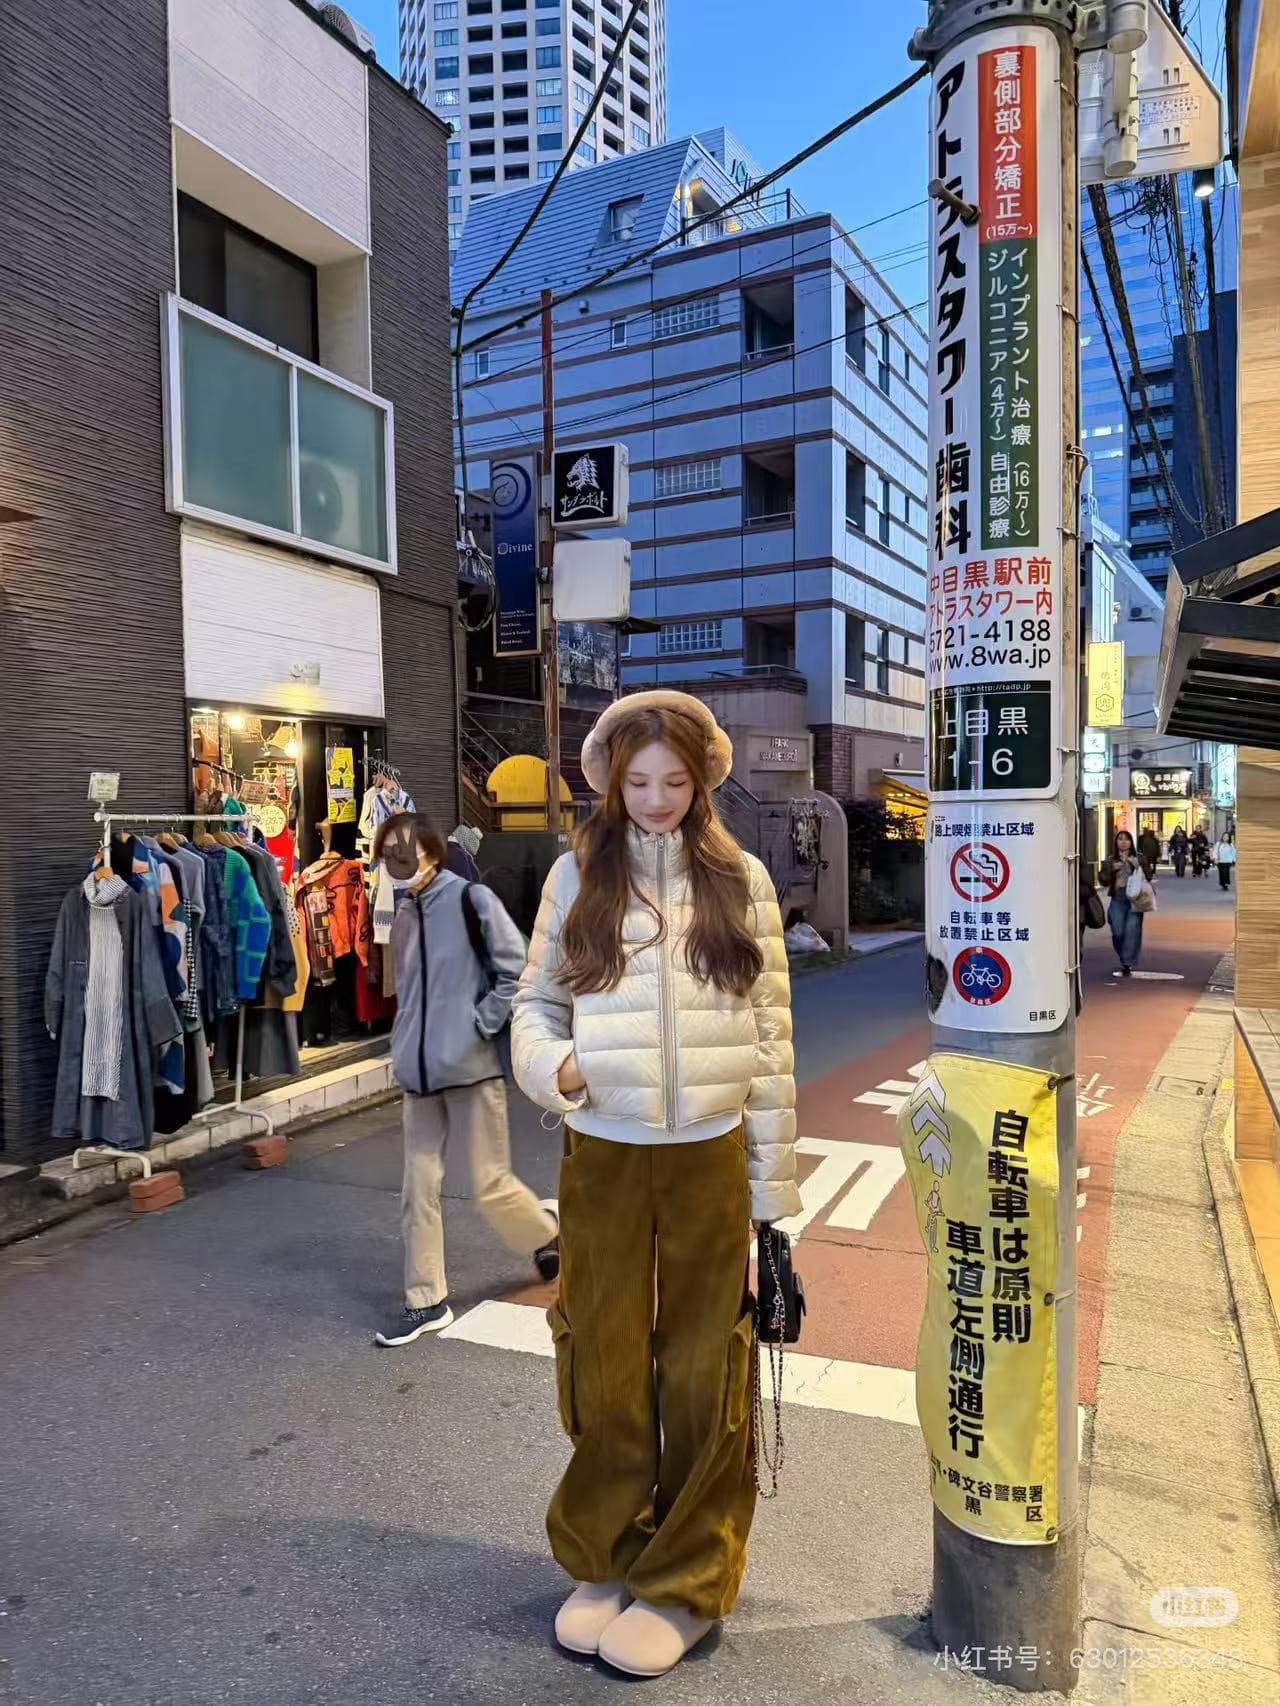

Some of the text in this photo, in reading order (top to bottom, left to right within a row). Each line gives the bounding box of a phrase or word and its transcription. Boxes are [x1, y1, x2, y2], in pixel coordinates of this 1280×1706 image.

[993, 51, 1022, 220] 裏側部分矯正
[497, 542, 533, 555] Divine
[930, 556, 1052, 597] 中目黒駅前
[930, 587, 1052, 629] アトラスタワー内
[939, 707, 1029, 736] 上目黒
[948, 748, 1014, 776] 1-6
[940, 925, 1030, 941] 放置禁止区域
[950, 911, 1011, 926] 自転車等
[1029, 1010, 1057, 1021] 目黒区
[987, 1109, 1032, 1344] 自転車は原則
[945, 1218, 985, 1460] 車道左側通行
